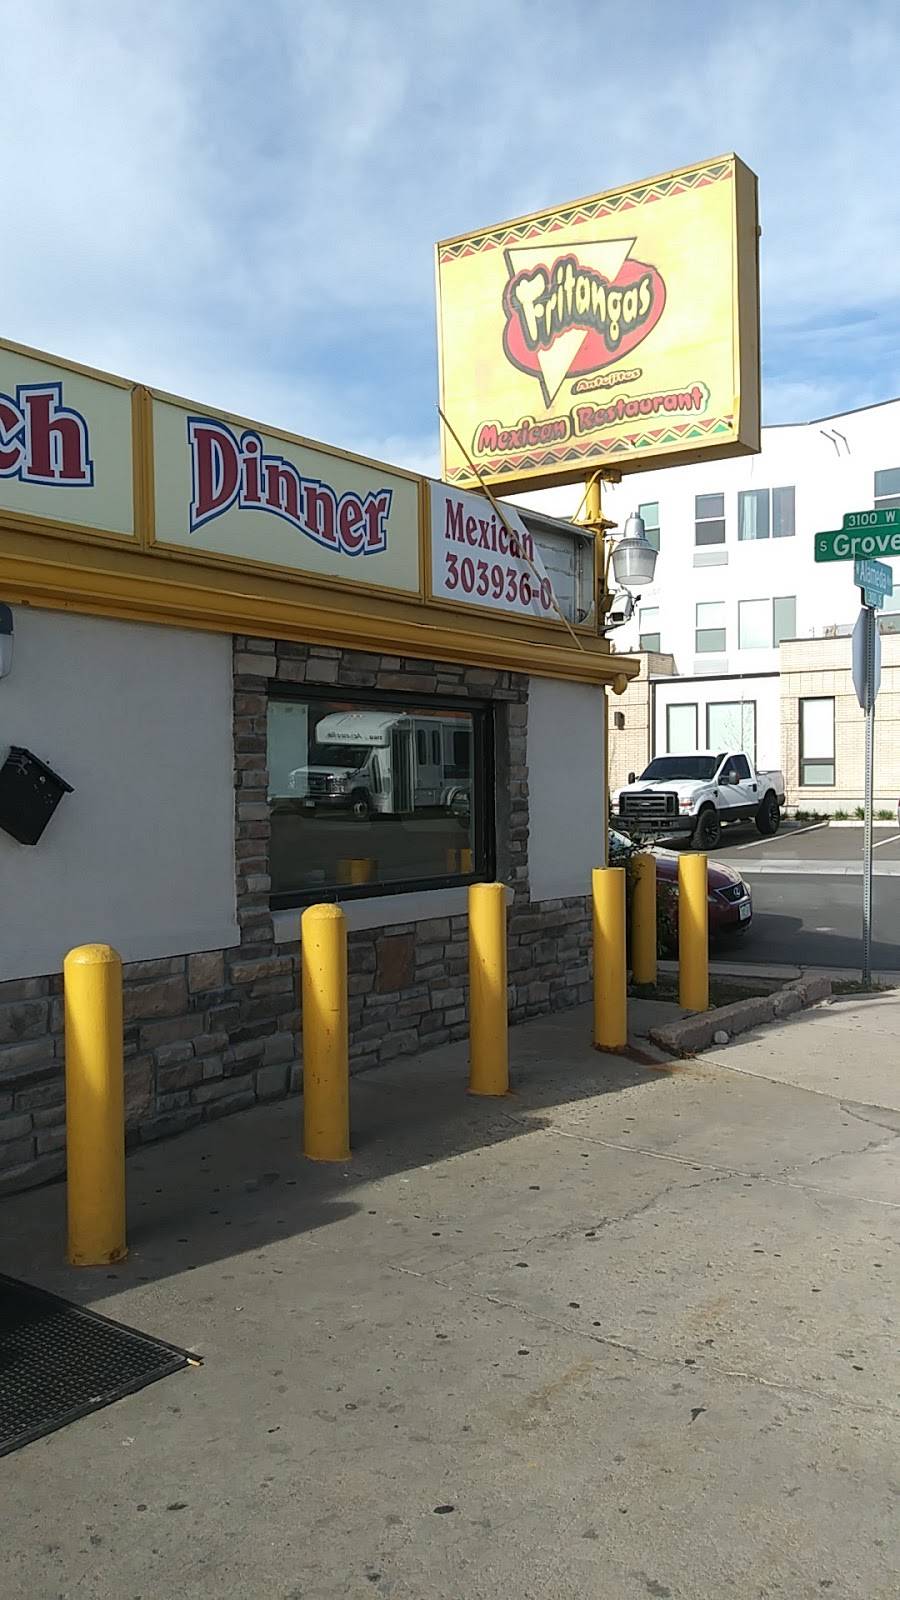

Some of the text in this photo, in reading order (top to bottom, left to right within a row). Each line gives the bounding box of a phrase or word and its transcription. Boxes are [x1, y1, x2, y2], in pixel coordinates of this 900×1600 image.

[513, 262, 653, 344] Fritangas
[477, 386, 704, 453] Mexican Restaurant
[188, 417, 391, 555] Dinner
[848, 510, 896, 527] 3100 W
[445, 498, 534, 562] Mexican
[820, 533, 900, 556] S Grove
